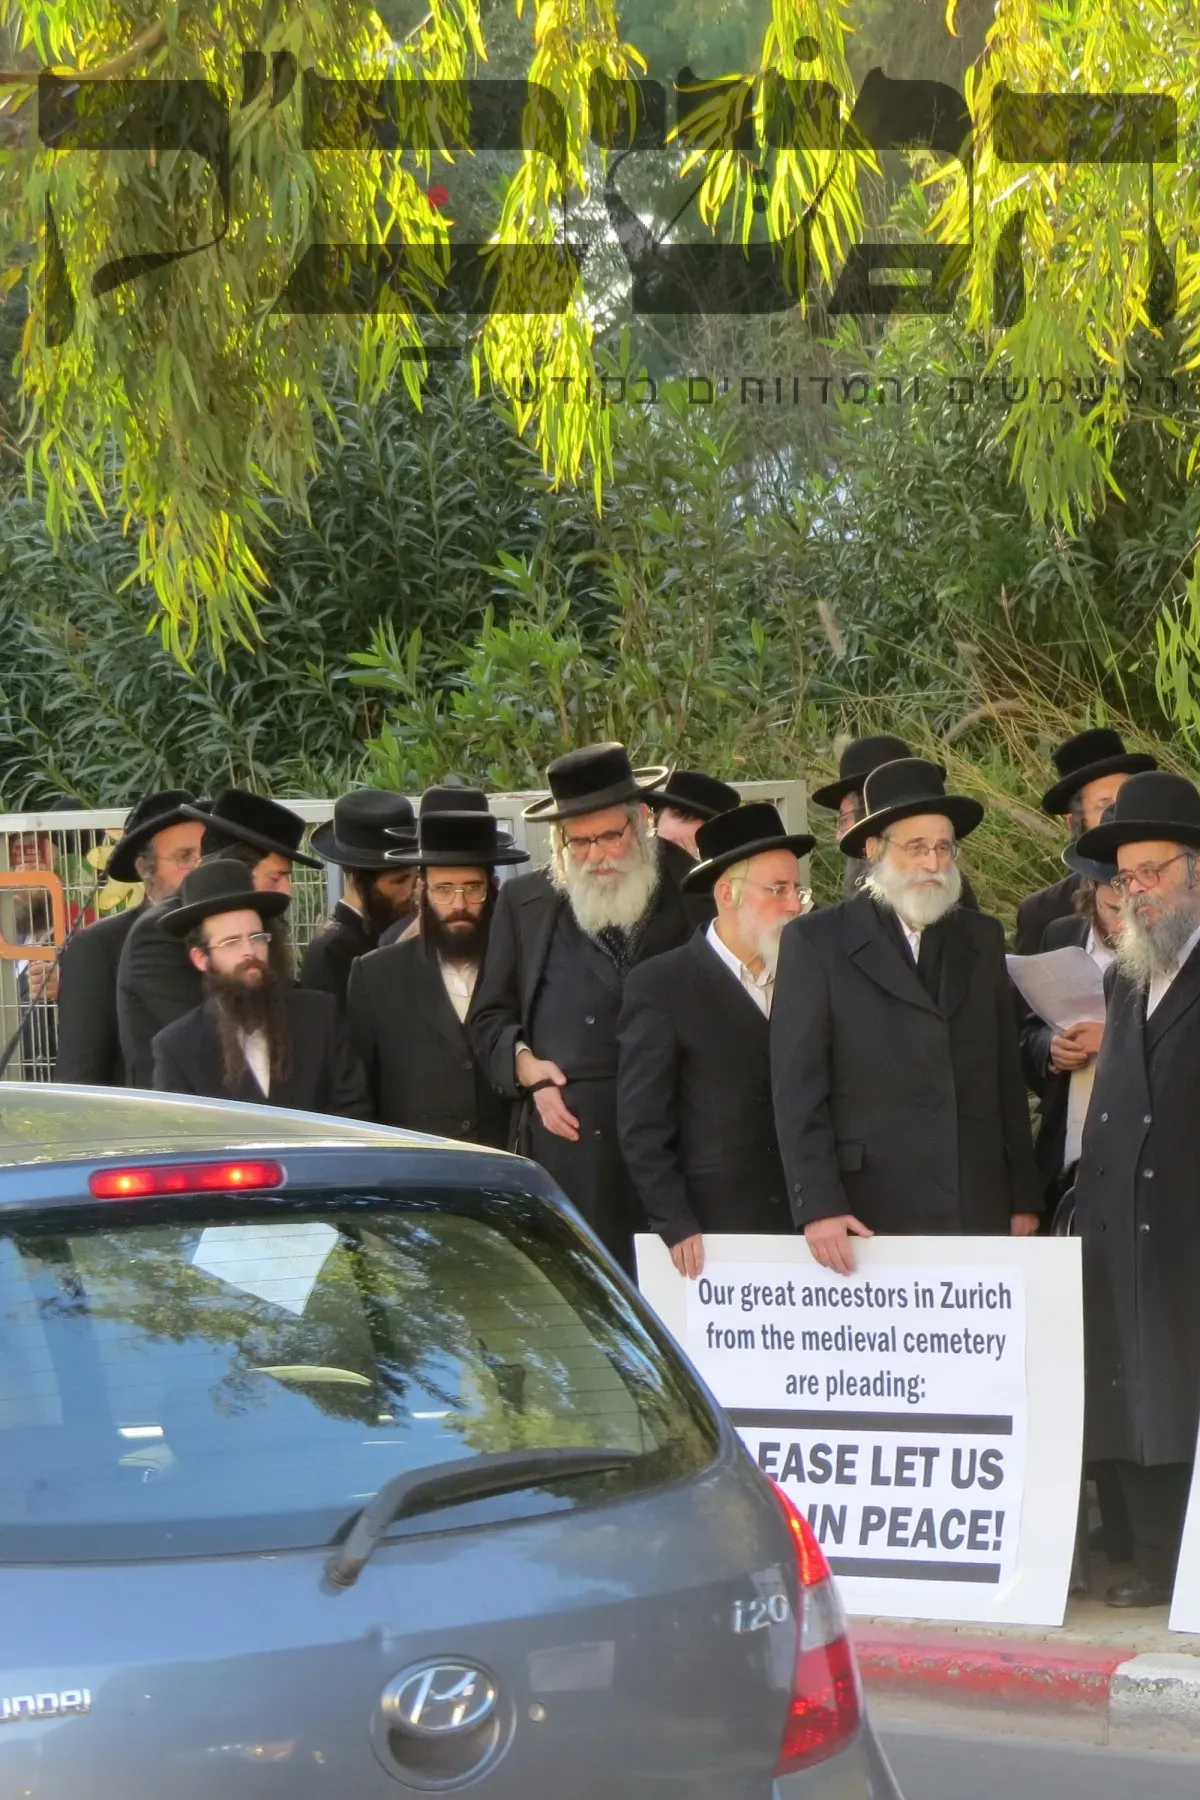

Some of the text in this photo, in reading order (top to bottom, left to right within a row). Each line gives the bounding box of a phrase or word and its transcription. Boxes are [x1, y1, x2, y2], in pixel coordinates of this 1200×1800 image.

[698, 1278, 1012, 1312] Our great ancestors in Zurich
[706, 1321, 1006, 1361] from the medieval cemetery
[785, 1369, 926, 1405] are pleading:
[758, 1442, 1004, 1491] EASE LET US
[807, 1504, 1006, 1552] IN PEACE!
[733, 1594, 790, 1634] i20
